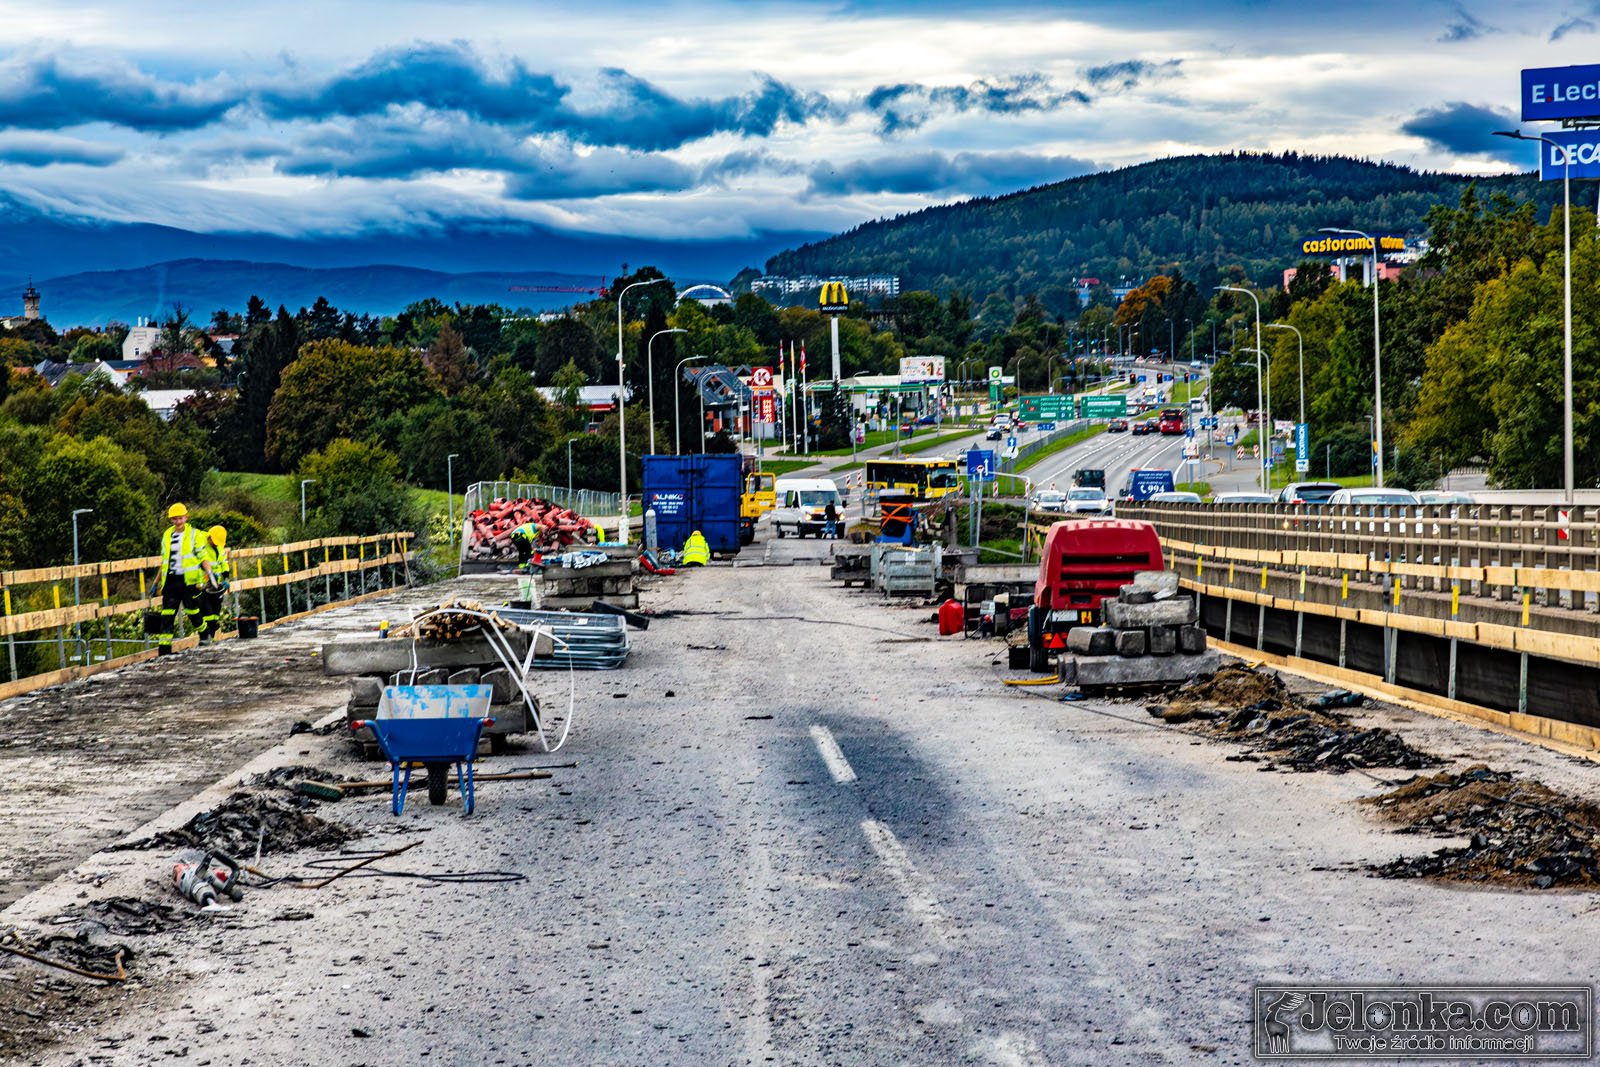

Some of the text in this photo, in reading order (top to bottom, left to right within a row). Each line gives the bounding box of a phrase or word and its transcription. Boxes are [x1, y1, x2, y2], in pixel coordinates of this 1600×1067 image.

[1532, 82, 1600, 103] E.Lec
[1303, 237, 1375, 253] castorama
[1147, 485, 1165, 493] 994
